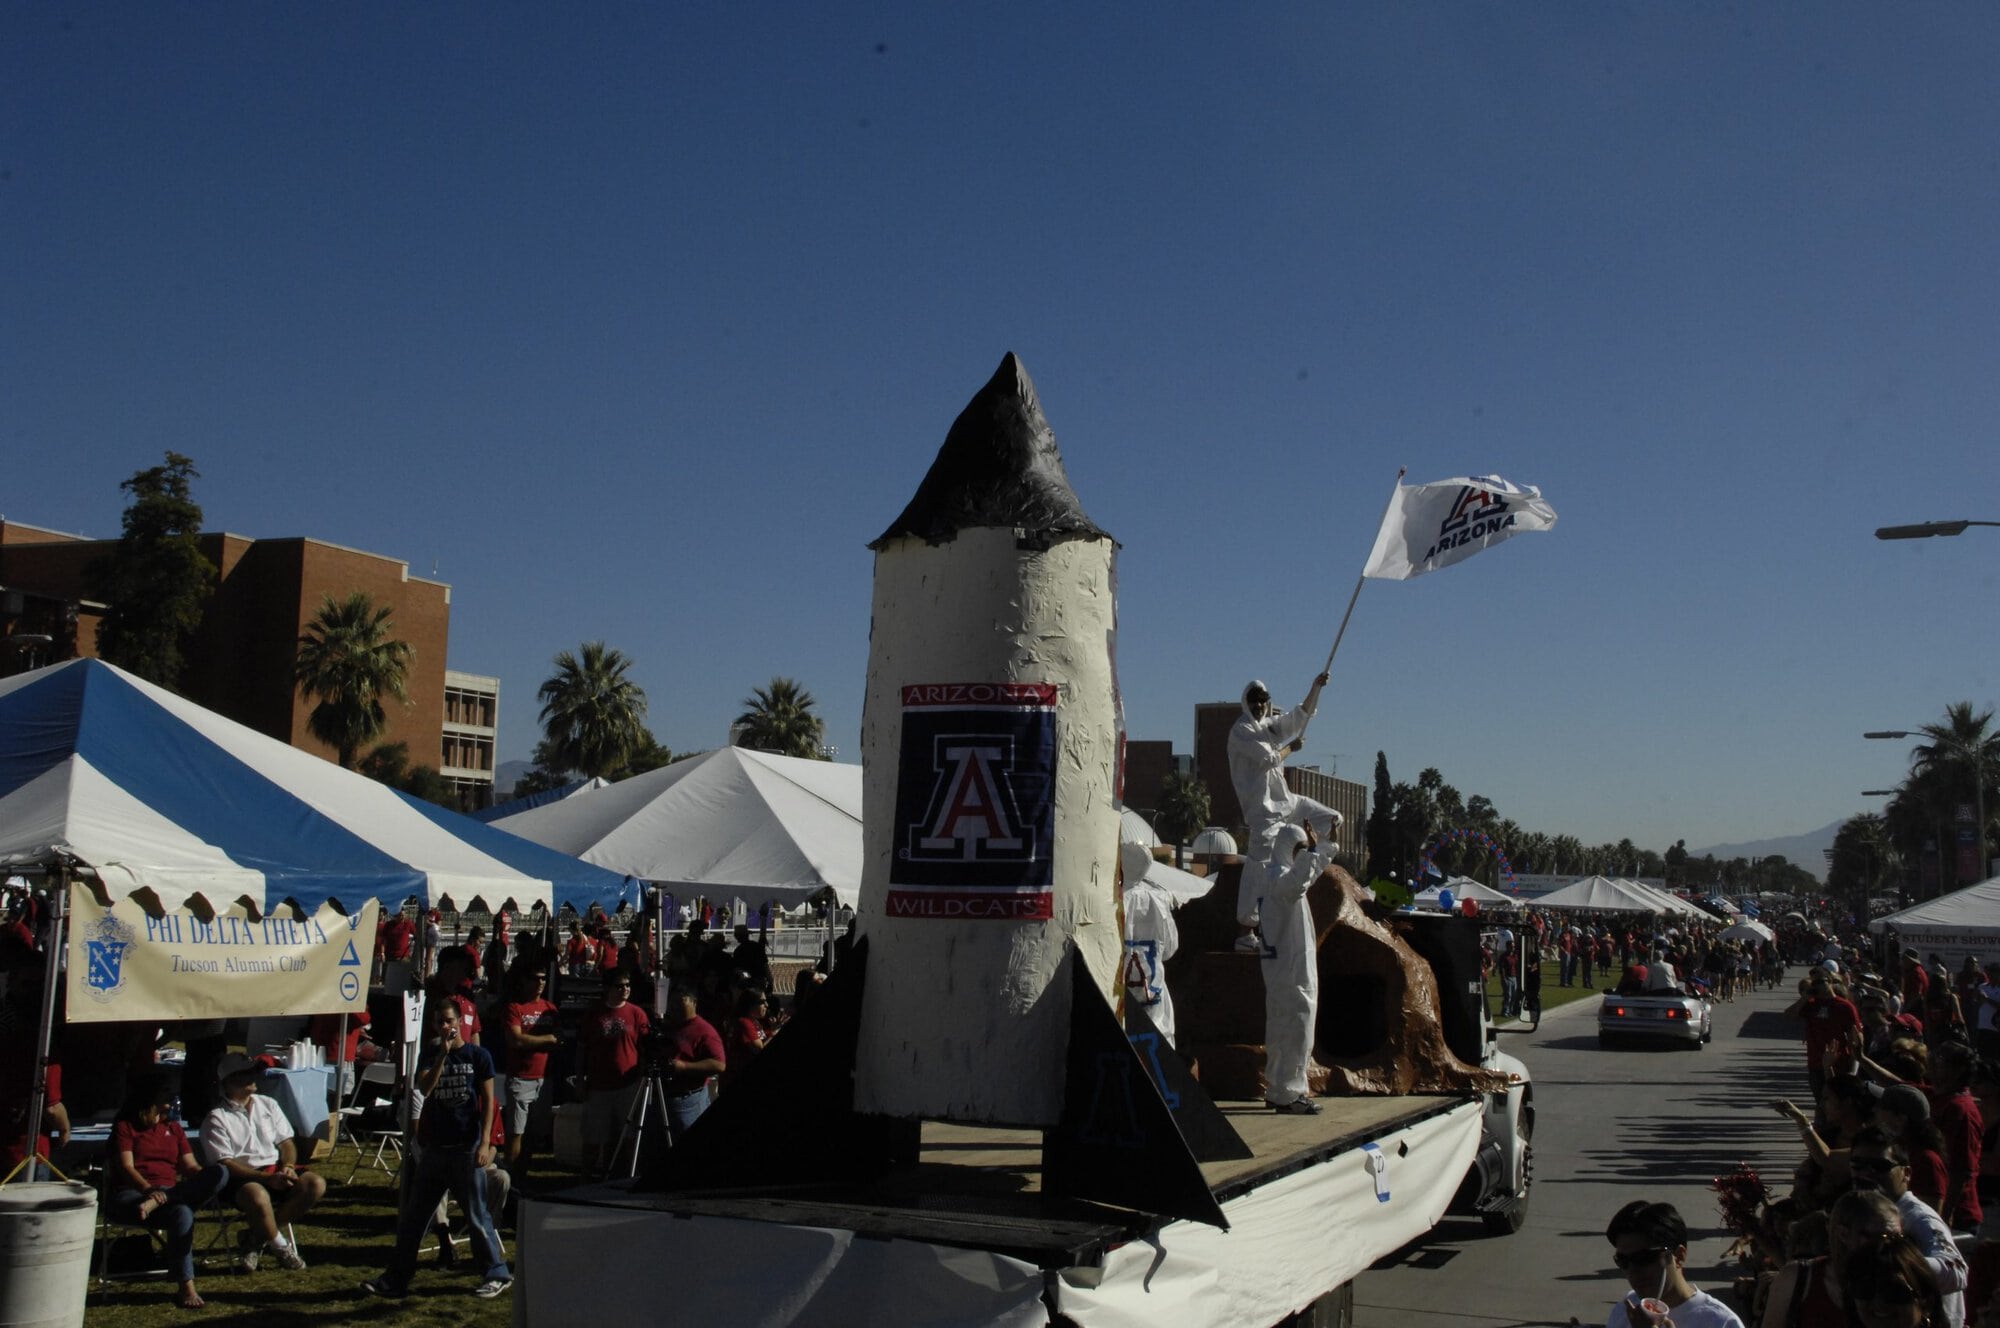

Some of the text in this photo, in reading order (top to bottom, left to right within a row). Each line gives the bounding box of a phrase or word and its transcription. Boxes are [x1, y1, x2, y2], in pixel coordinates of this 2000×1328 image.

[1423, 513, 1516, 562] ARIZONA
[906, 684, 1041, 704] ARIZONA
[908, 733, 1037, 863] A
[892, 897, 1037, 917] WILDCATS
[145, 914, 328, 945] PHI DELTA THETA
[1902, 934, 1958, 945] STUDENT
[171, 955, 307, 973] Tucson Alumni Club
